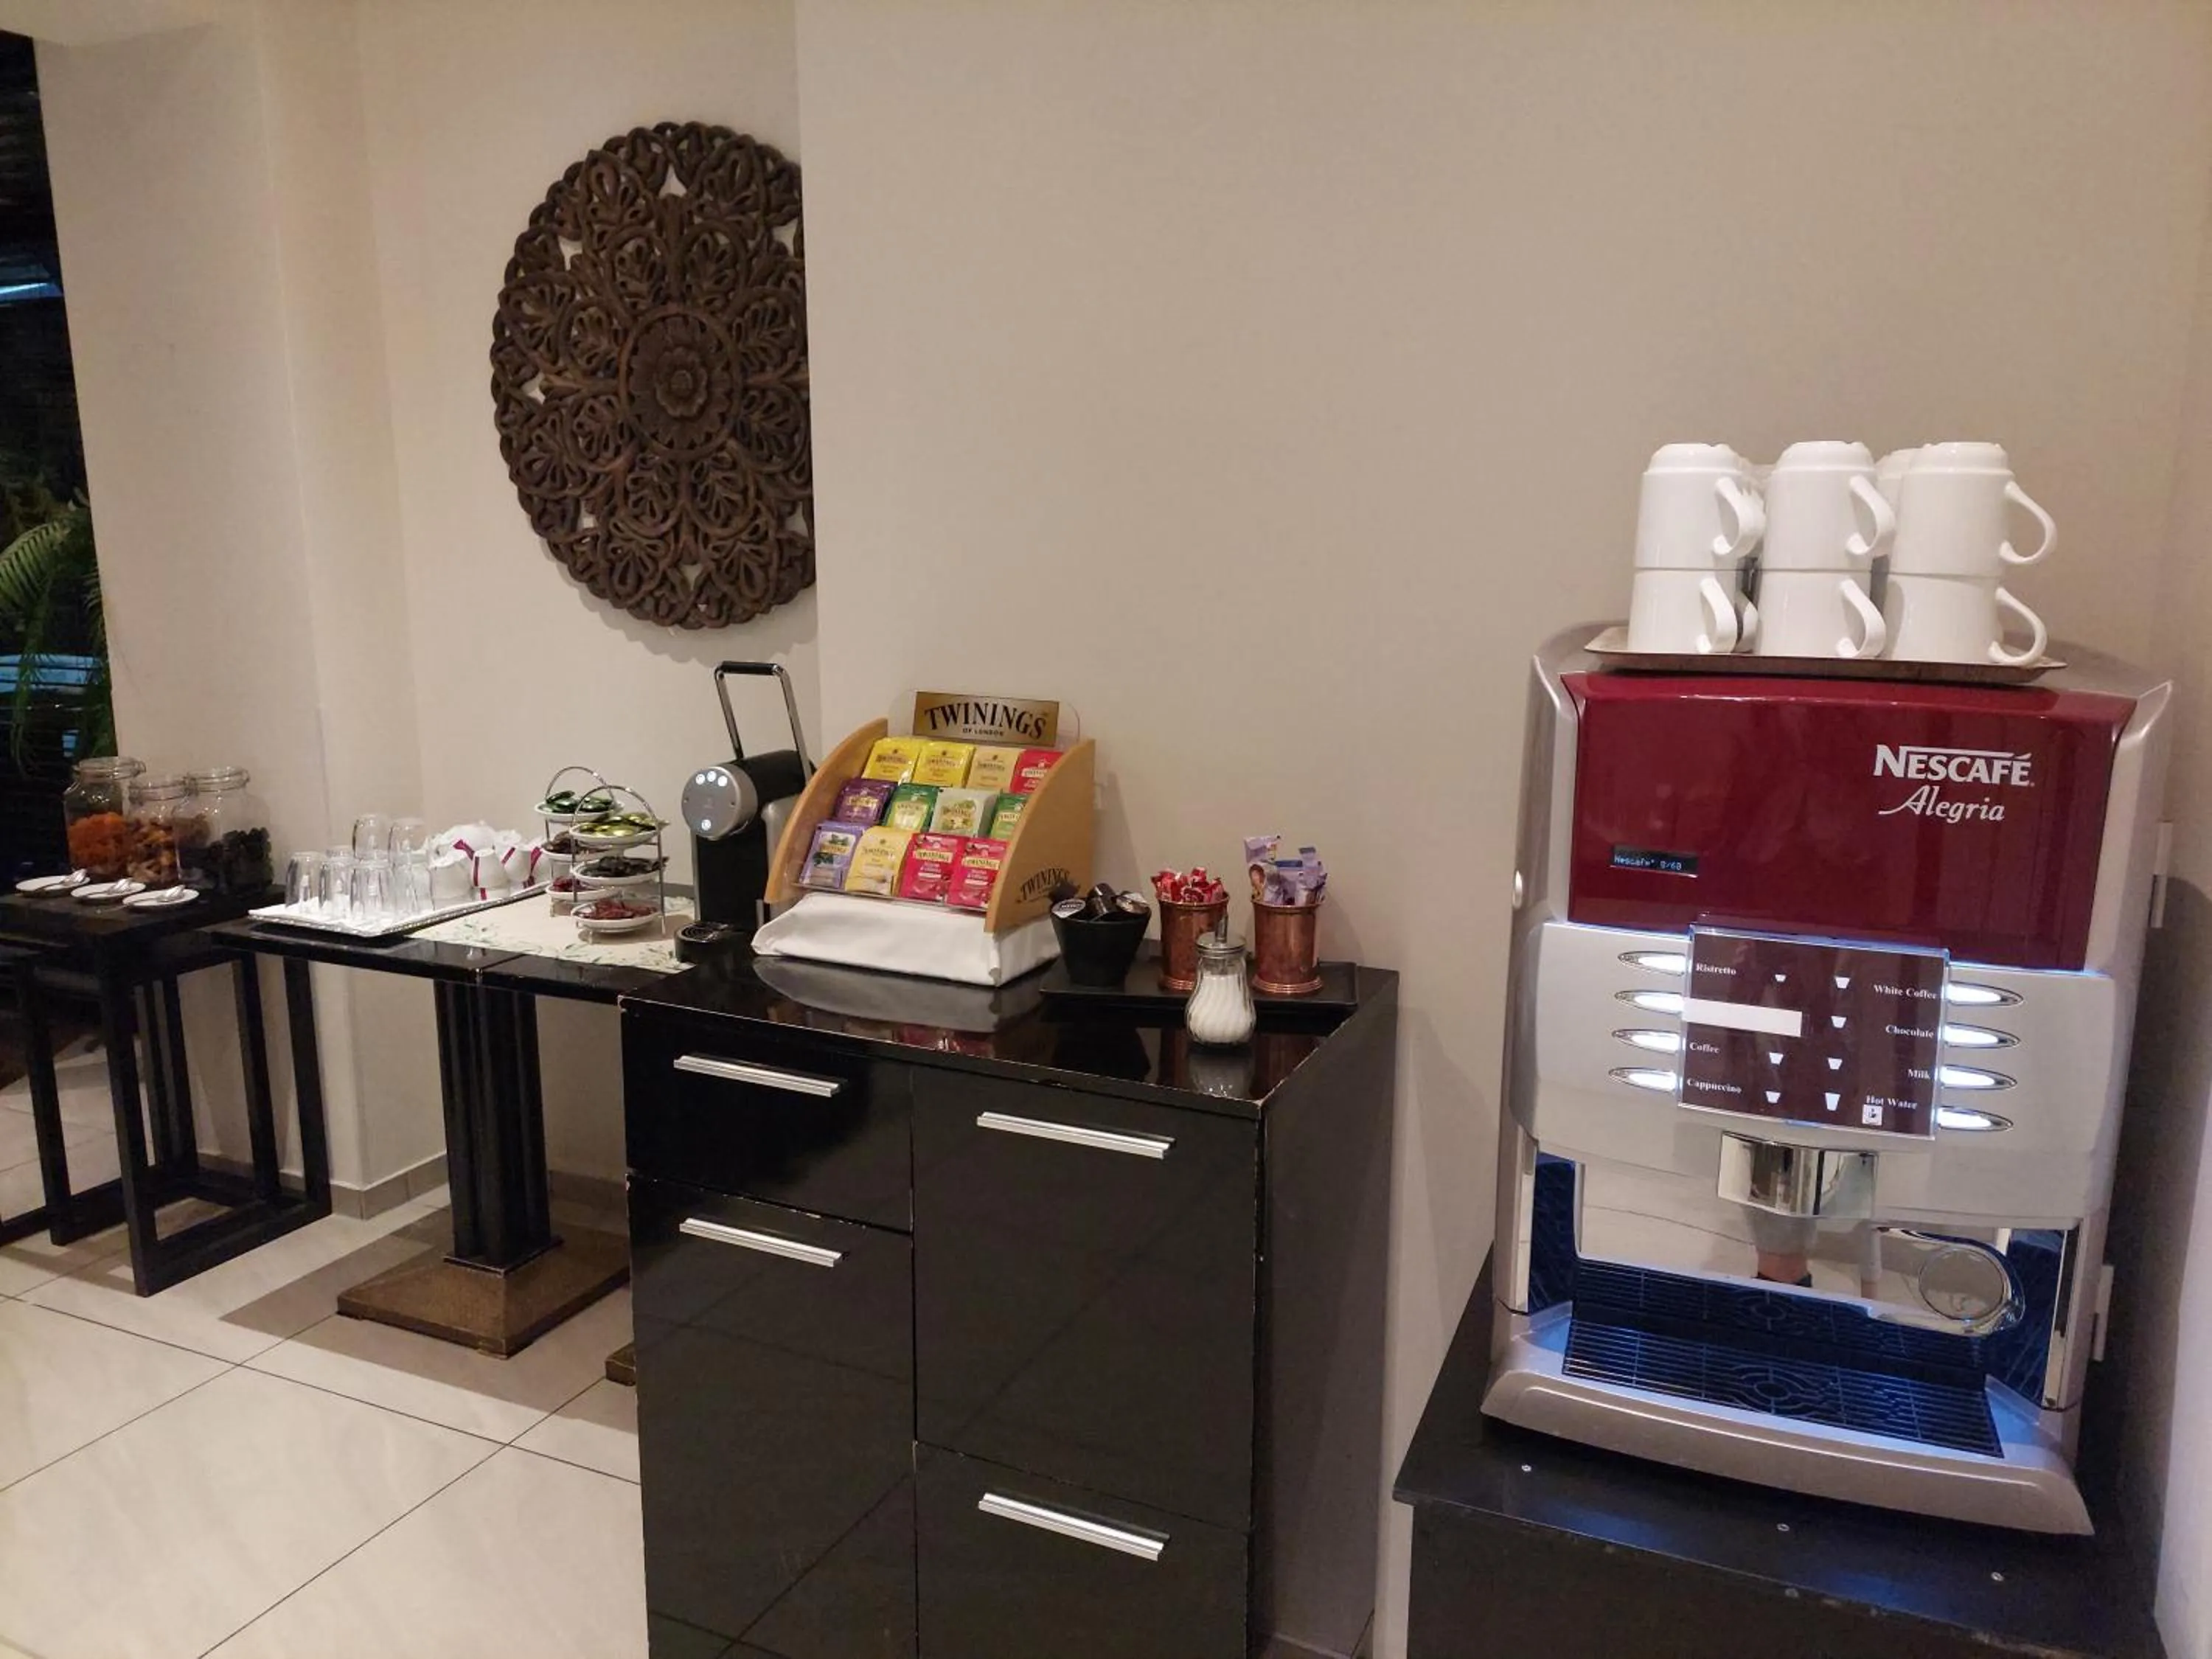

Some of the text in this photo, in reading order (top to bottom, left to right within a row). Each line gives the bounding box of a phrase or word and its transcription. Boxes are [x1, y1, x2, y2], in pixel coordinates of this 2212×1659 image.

[924, 702, 1047, 740] TWININGS
[1873, 744, 2032, 787] NESCAFÉ
[1878, 785, 2005, 824] Alegria
[1696, 962, 1736, 976] Ristretto
[1874, 984, 1937, 1001] White Coffee
[1885, 1025, 1934, 1038] Chocolate
[1689, 1043, 1719, 1054] Coffee
[1908, 1068, 1930, 1079] Milk
[1686, 1078, 1742, 1093] Cappuccino
[1865, 1094, 1917, 1110] Hot Water
